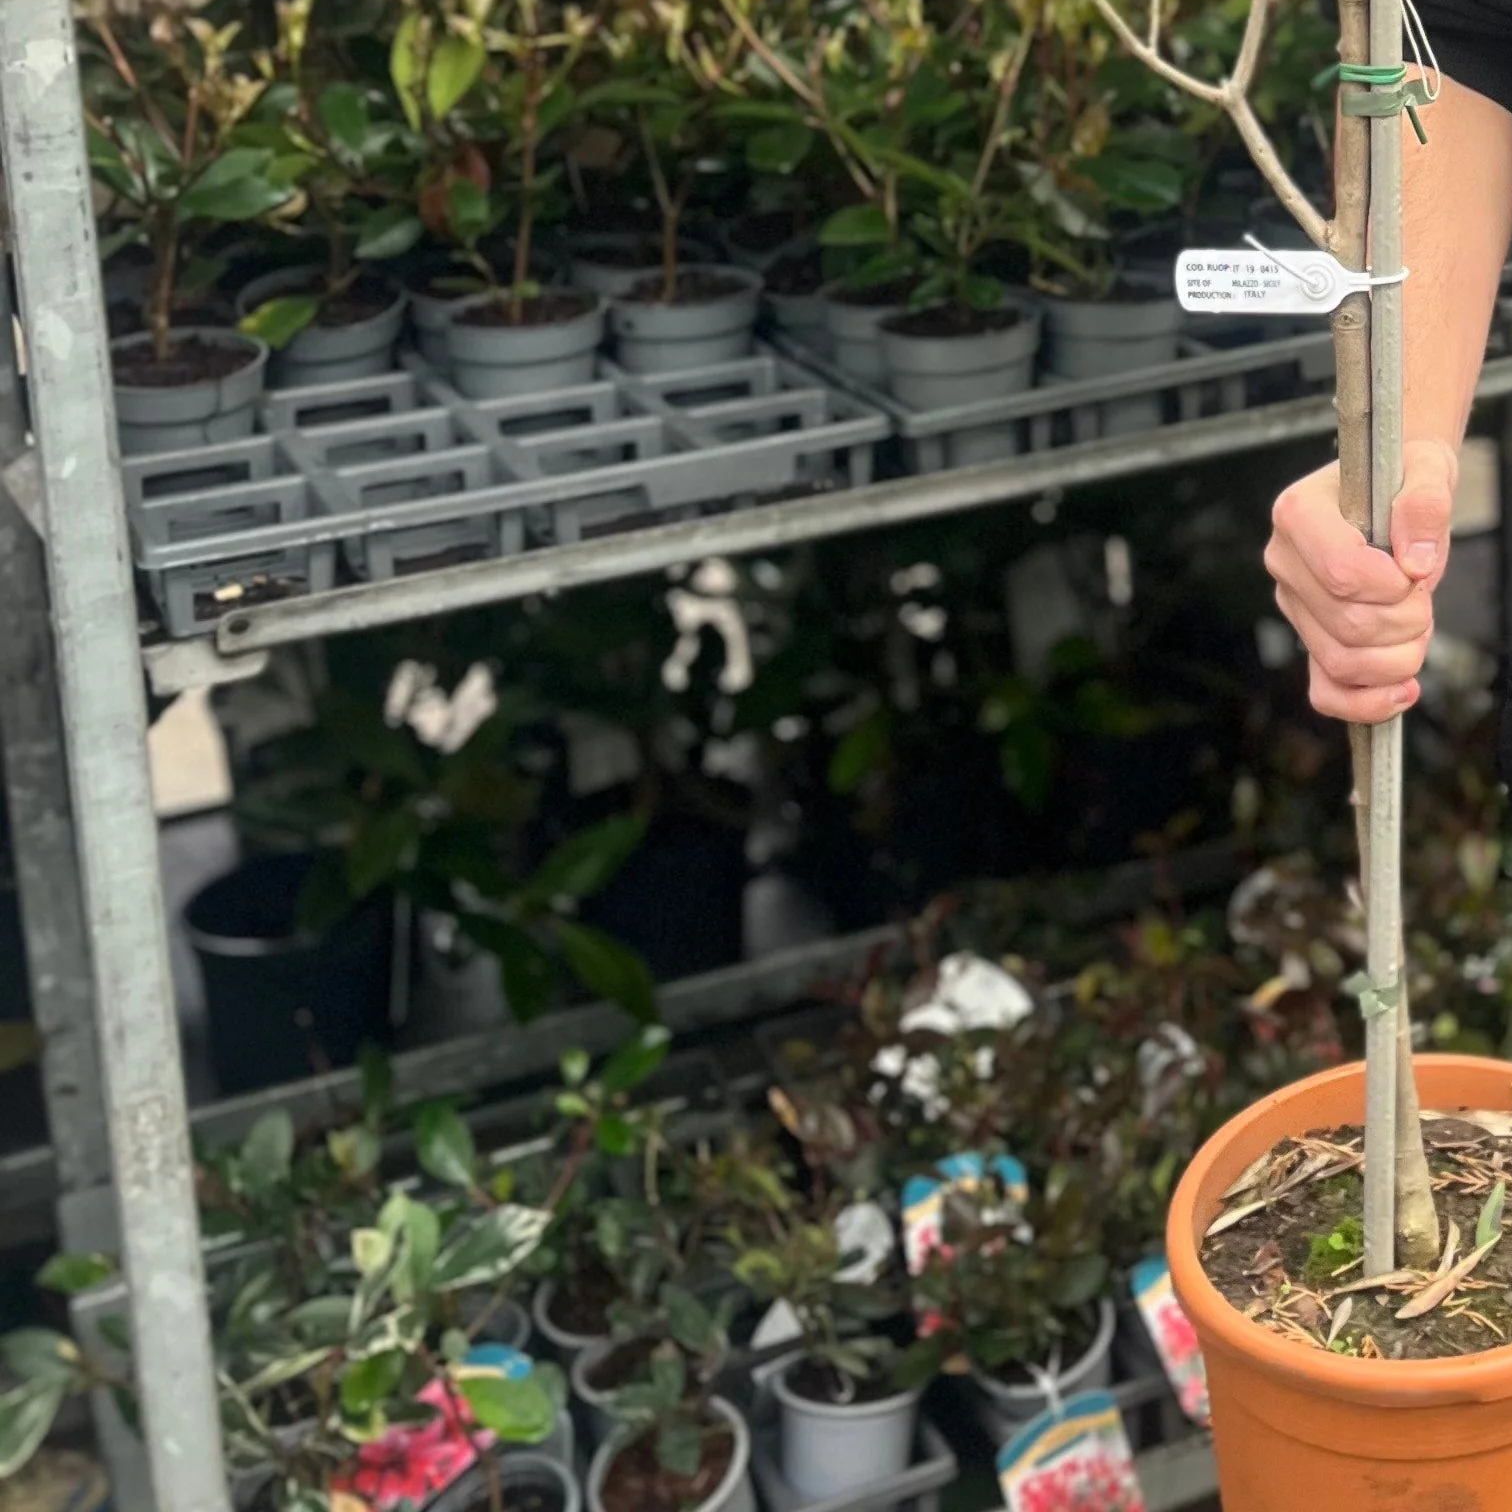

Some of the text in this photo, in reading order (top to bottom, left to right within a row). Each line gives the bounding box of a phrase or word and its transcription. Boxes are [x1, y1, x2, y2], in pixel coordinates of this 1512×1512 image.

[1187, 279, 1200, 287] SITE
[1202, 279, 1212, 287] OF
[1244, 290, 1266, 299] ITALY
